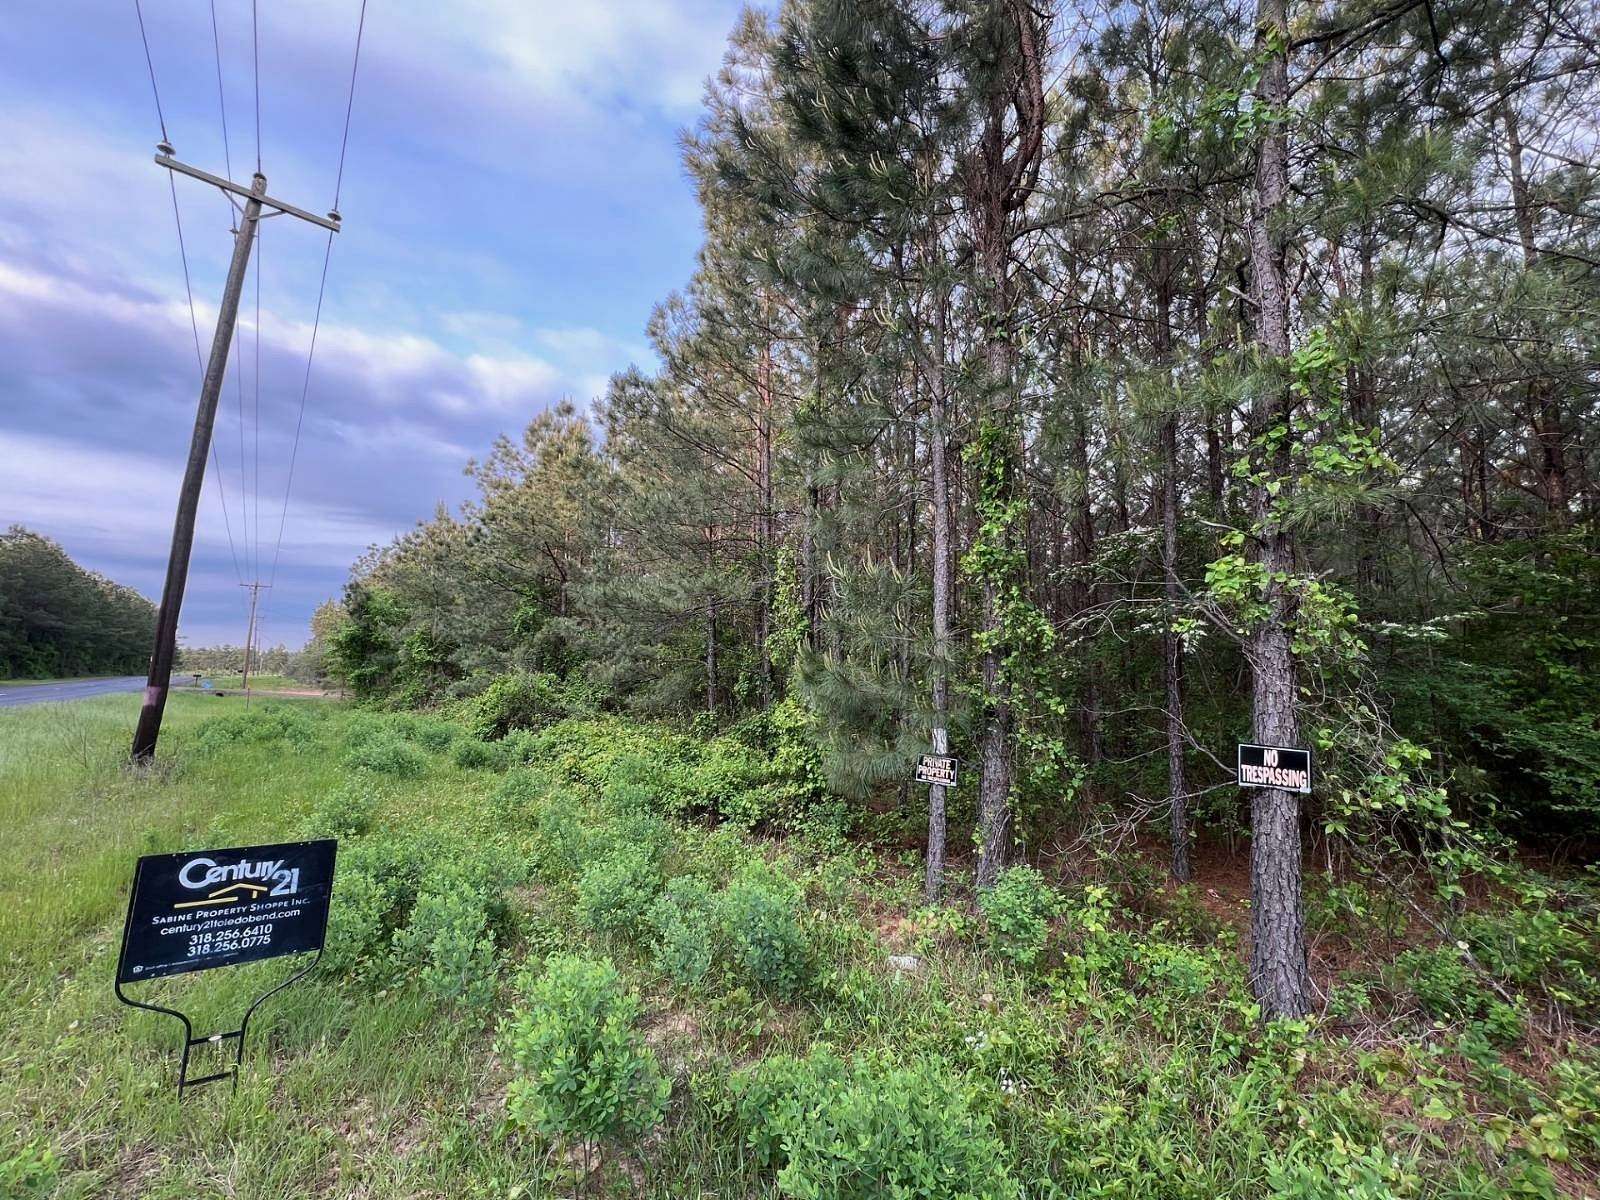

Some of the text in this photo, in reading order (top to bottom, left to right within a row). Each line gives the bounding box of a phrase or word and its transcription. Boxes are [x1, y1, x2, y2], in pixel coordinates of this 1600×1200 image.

[922, 756, 951, 769] PRIVATE
[1264, 749, 1279, 768] NO
[918, 764, 955, 780] PROPERTY
[1241, 764, 1307, 788] TRESPASSING
[178, 857, 299, 897] Century 21
[152, 913, 193, 925] SABINE
[196, 906, 247, 919] PROPERTY
[250, 900, 289, 912] SHOPPE
[160, 909, 300, 936] century21toledobend.com
[187, 934, 271, 957] 318.256.0775
[189, 924, 273, 945] 318.256.6410
